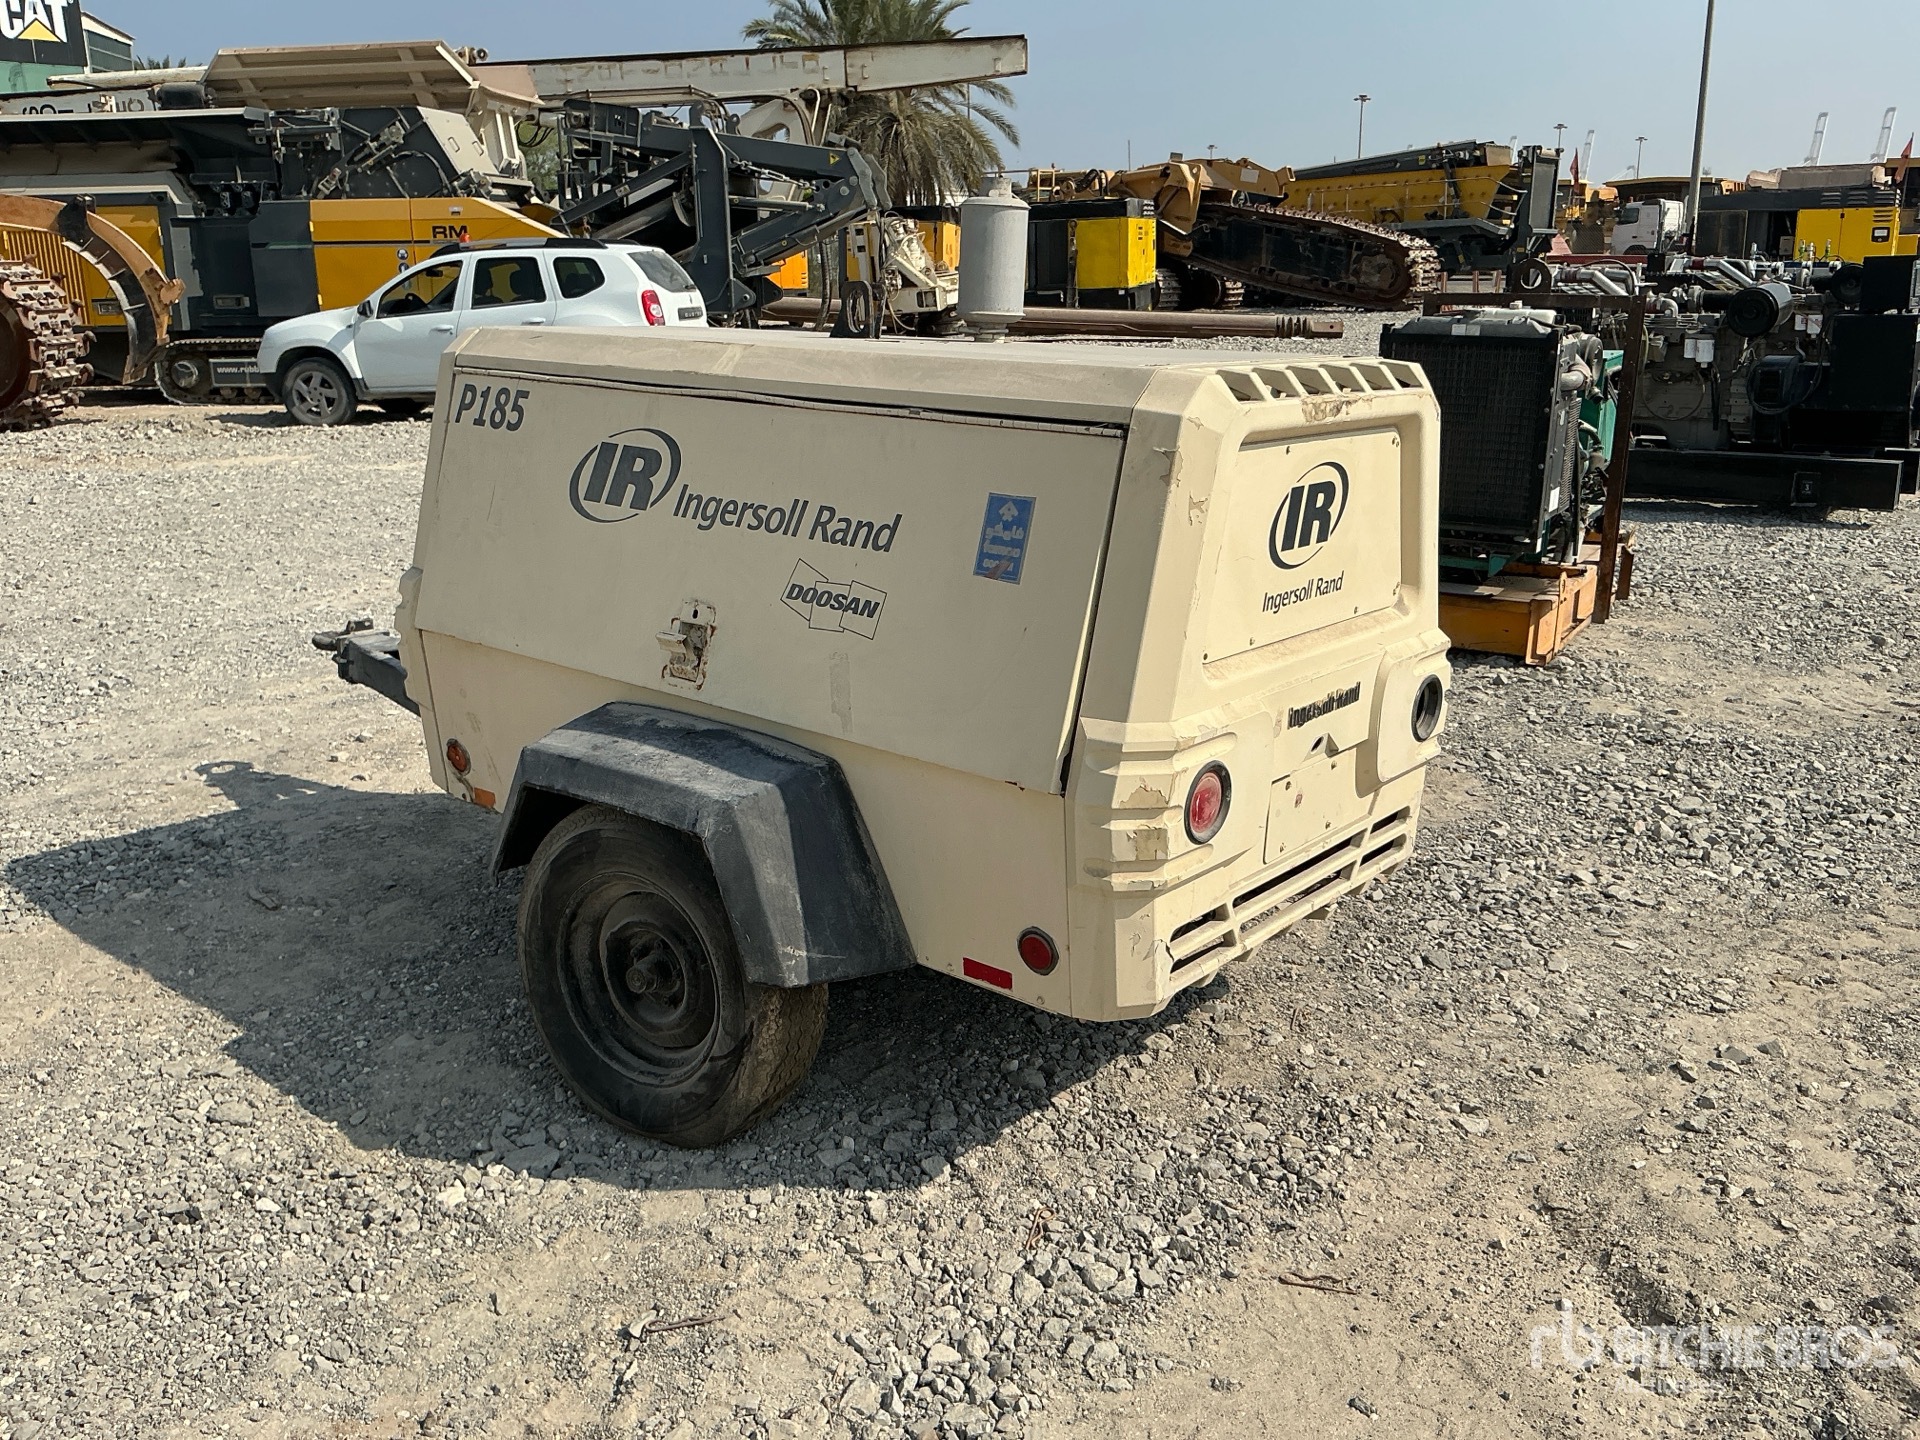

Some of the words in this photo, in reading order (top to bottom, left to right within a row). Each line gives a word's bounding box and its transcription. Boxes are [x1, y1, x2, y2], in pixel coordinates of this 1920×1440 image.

[0, 0, 68, 43] CAT
[432, 225, 468, 239] RM
[455, 383, 531, 432] P185
[583, 441, 663, 512] IR
[673, 484, 810, 538] Ingersoll
[808, 504, 903, 553] Rand
[1280, 480, 1337, 552] IR
[785, 583, 881, 619] DOOSAN
[1262, 578, 1315, 615] Ingersoll
[1314, 570, 1344, 598] Rand
